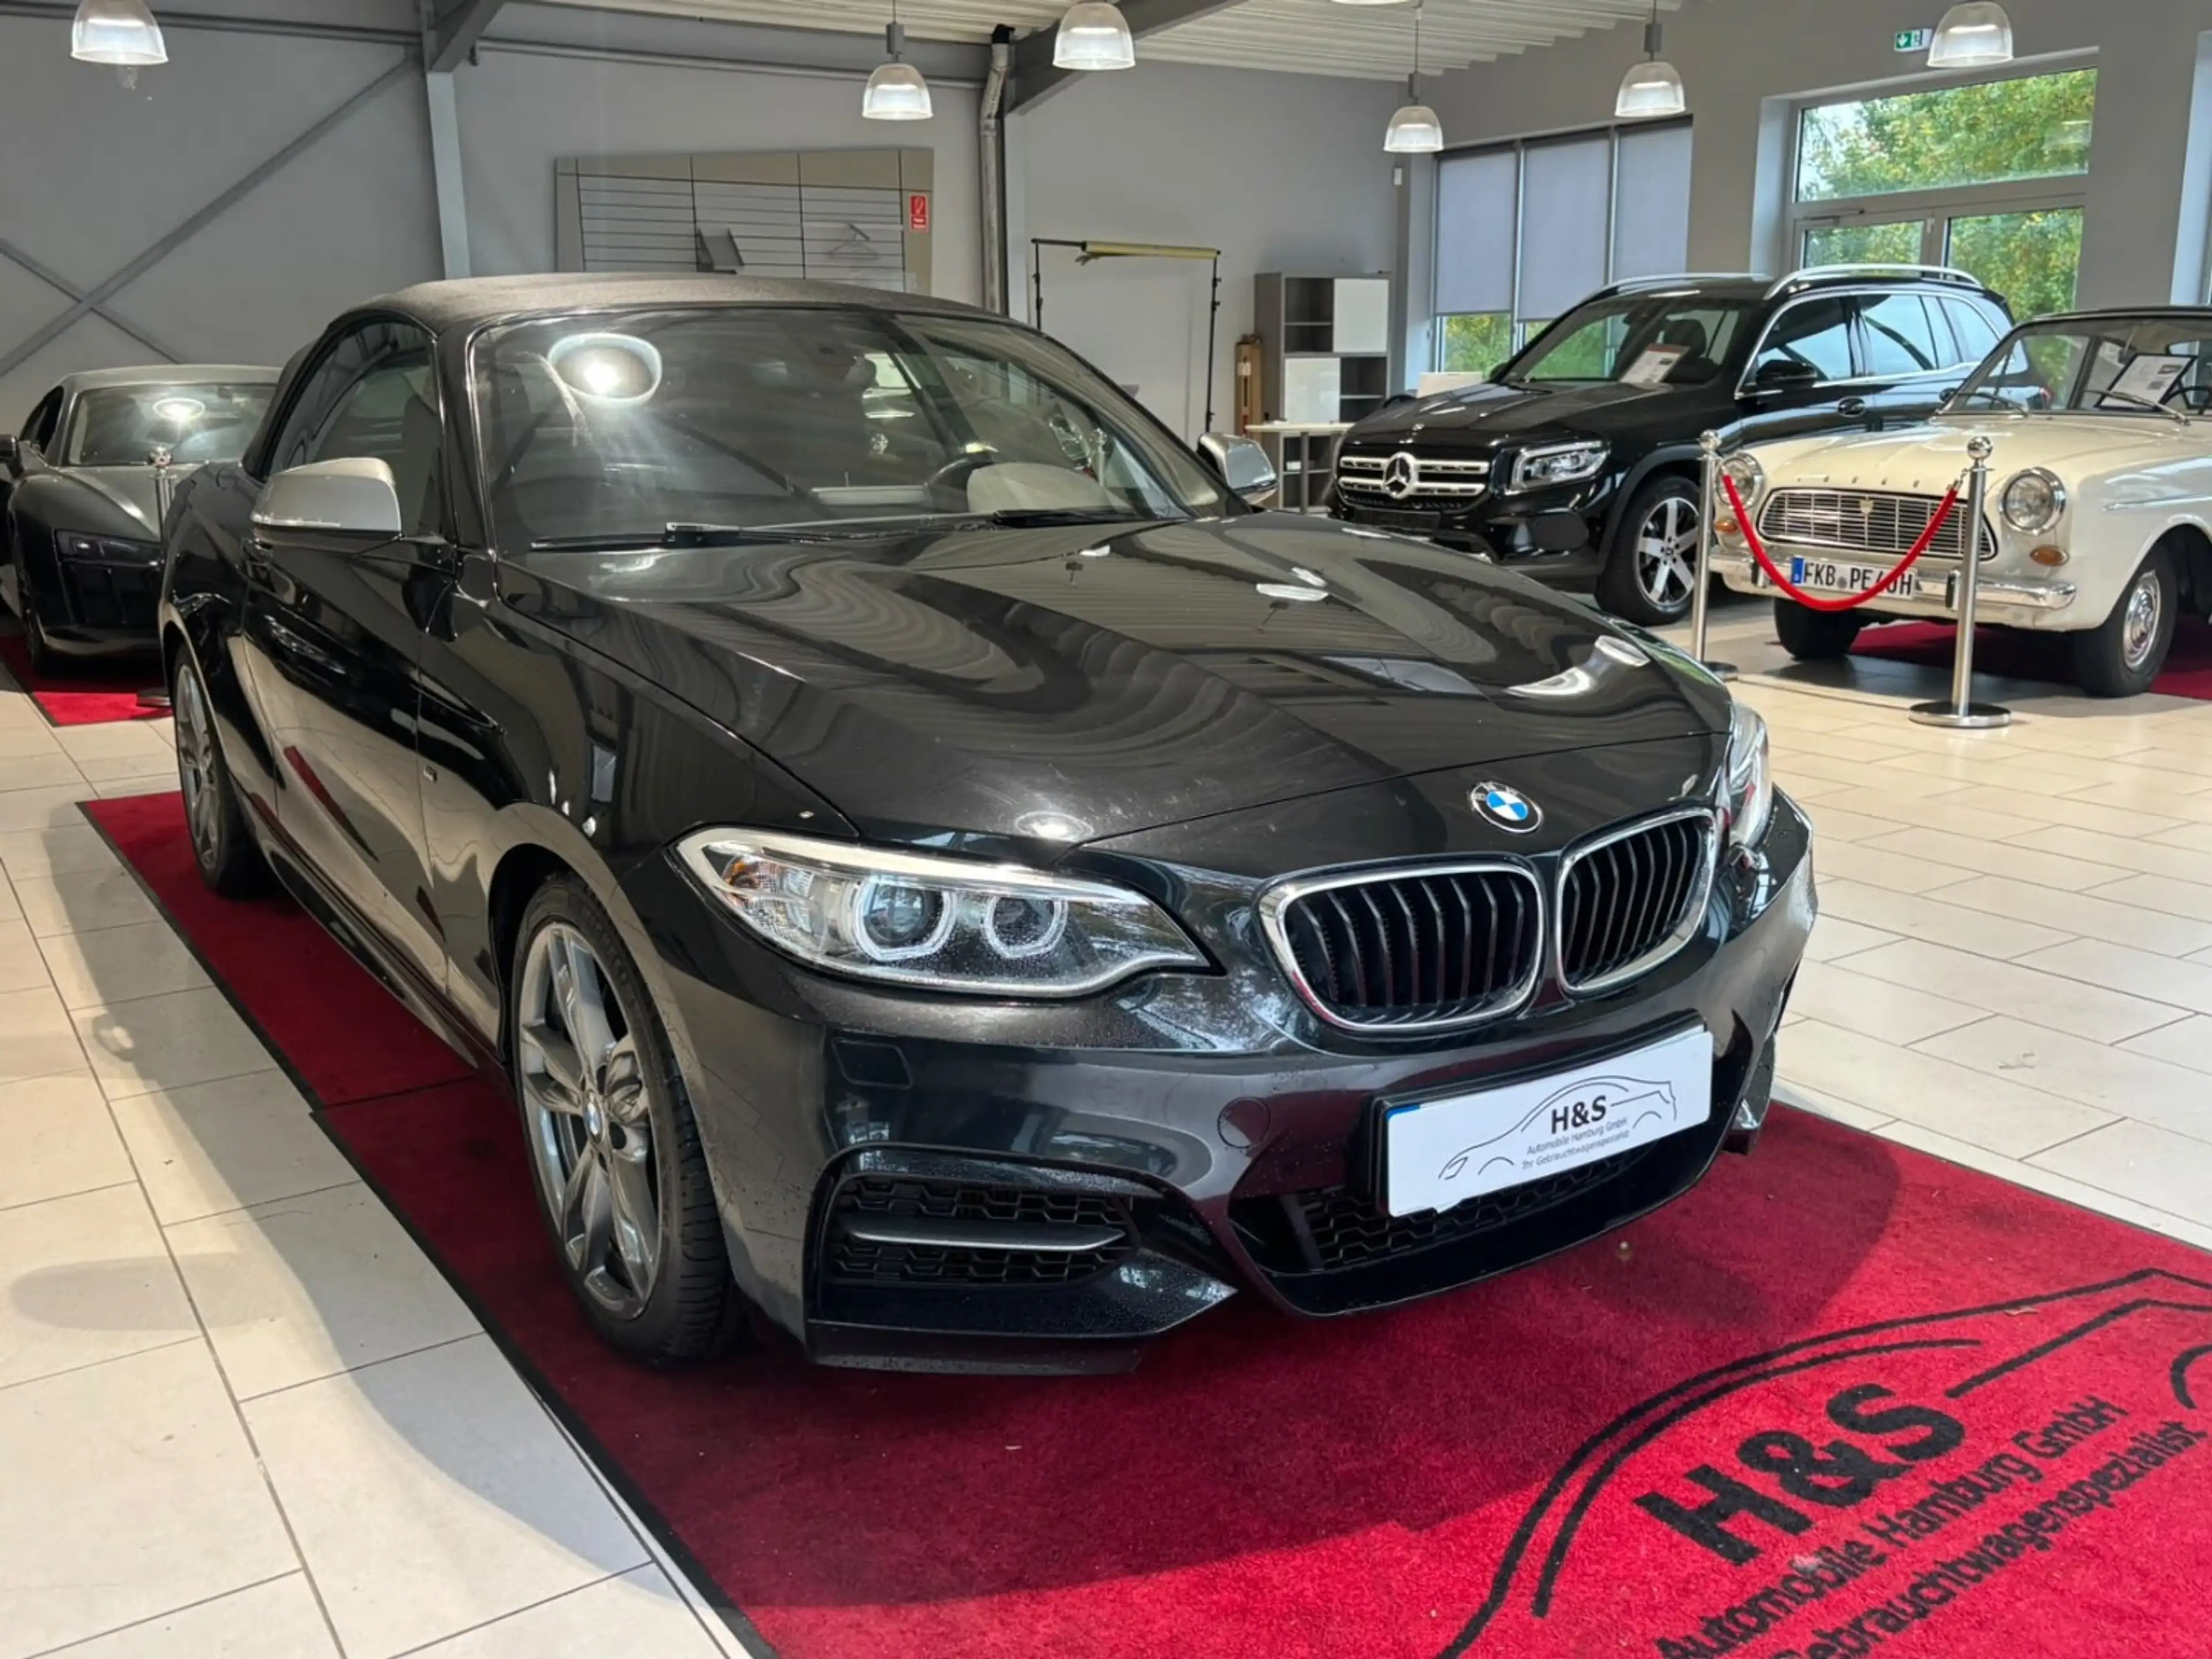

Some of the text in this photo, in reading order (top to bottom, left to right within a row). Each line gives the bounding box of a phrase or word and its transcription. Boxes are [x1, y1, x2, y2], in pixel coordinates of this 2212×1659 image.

[1551, 1094, 1607, 1134] H&S
[1634, 1383, 1965, 1566] H&S
[1656, 1395, 2128, 1659] Automobile Hamburg GmbH
